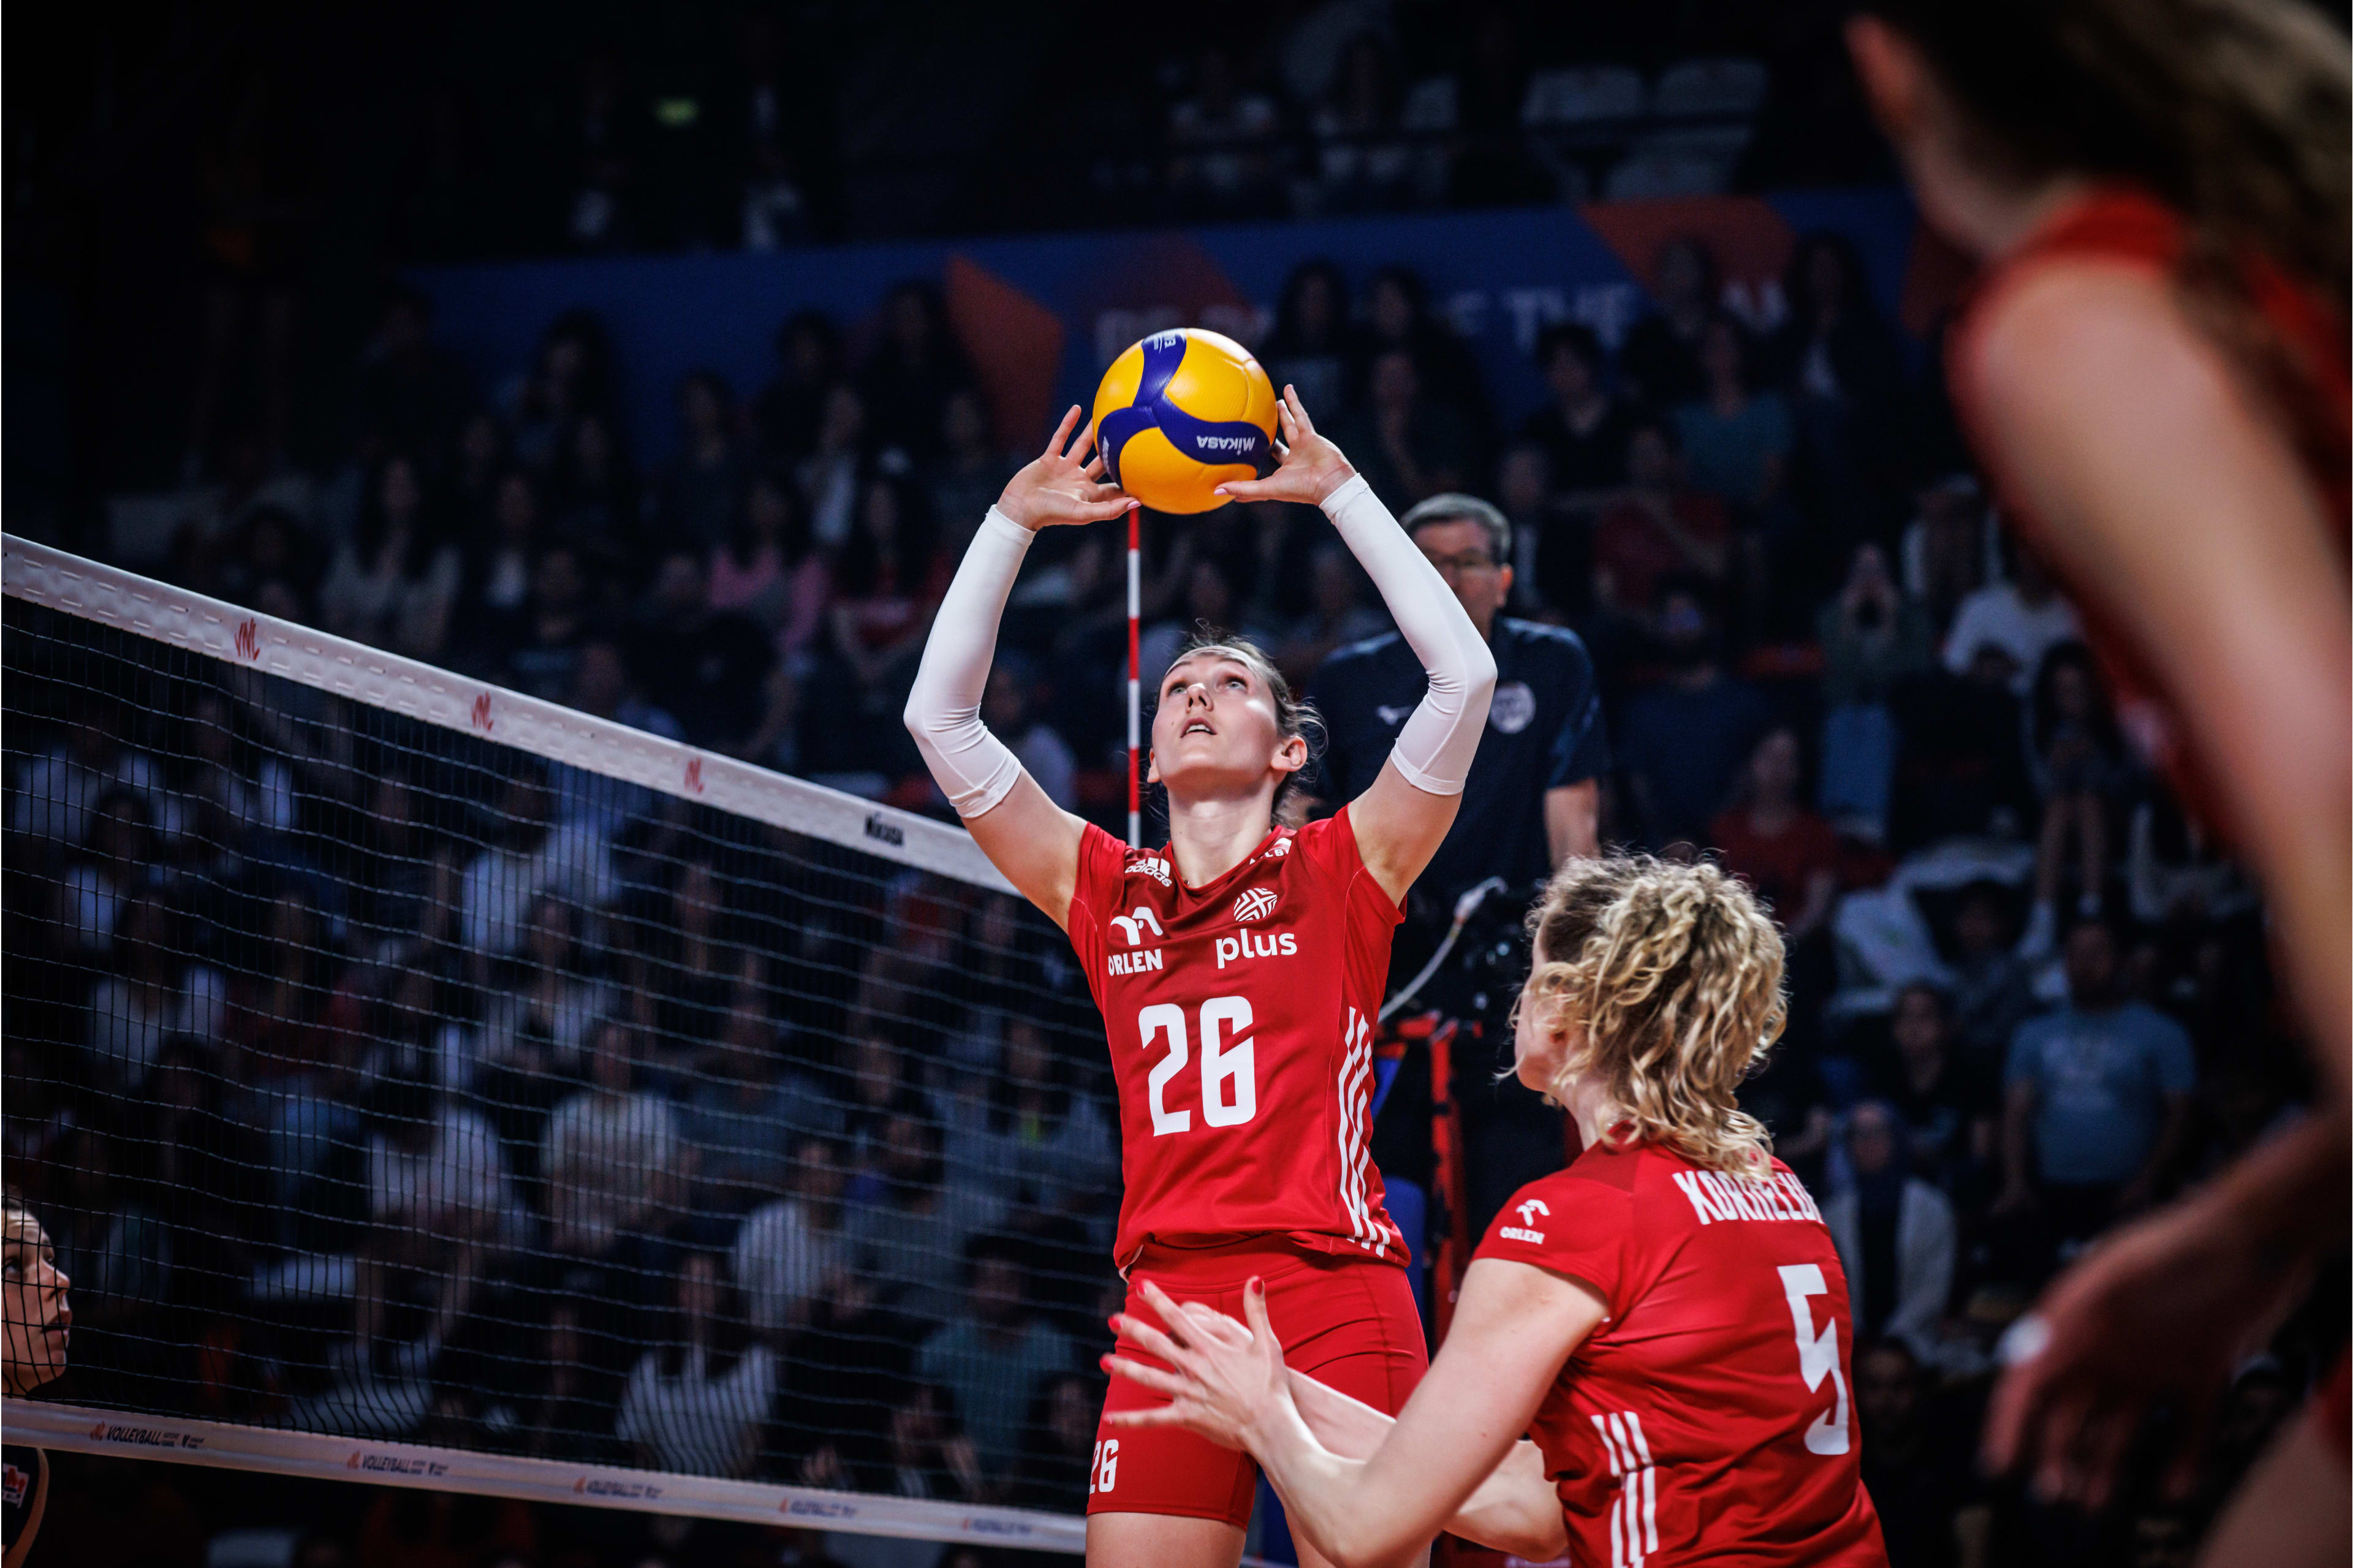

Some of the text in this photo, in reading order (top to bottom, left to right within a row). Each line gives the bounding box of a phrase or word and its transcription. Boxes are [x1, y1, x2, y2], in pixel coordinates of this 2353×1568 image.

[1124, 863, 1172, 887] adidas
[1216, 928, 1297, 969] plus
[1108, 949, 1163, 976] ORLEN
[1138, 995, 1256, 1137] 26
[1499, 1226, 1545, 1244] ORLEN
[1777, 1263, 1850, 1455] 5
[107, 1426, 162, 1445] VOLLEYBALL
